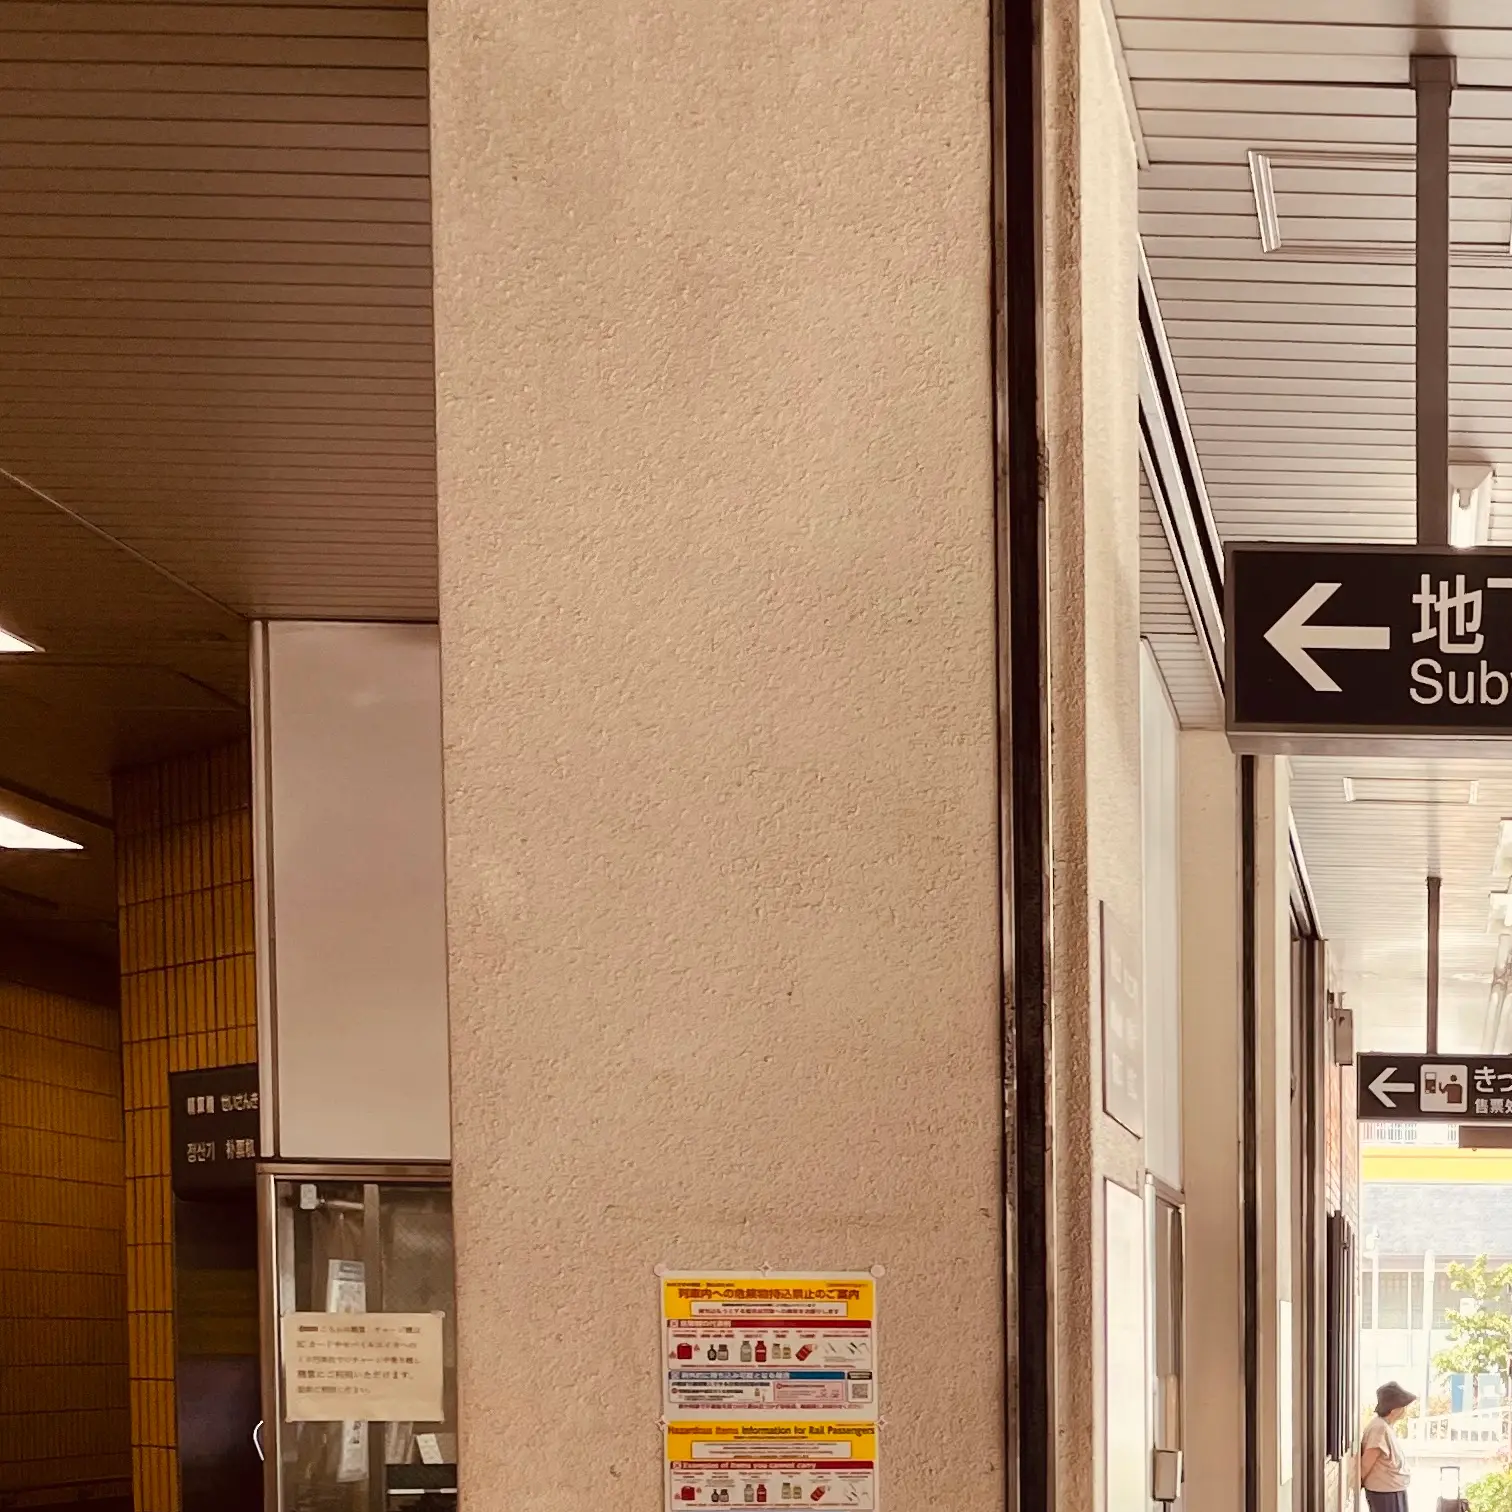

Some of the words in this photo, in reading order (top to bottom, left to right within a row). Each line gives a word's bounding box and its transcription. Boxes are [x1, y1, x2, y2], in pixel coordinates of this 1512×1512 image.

[741, 1426, 793, 1434] Information
[794, 1426, 806, 1434] for
[809, 1426, 825, 1434] Rail
[827, 1426, 875, 1437] Passengers
